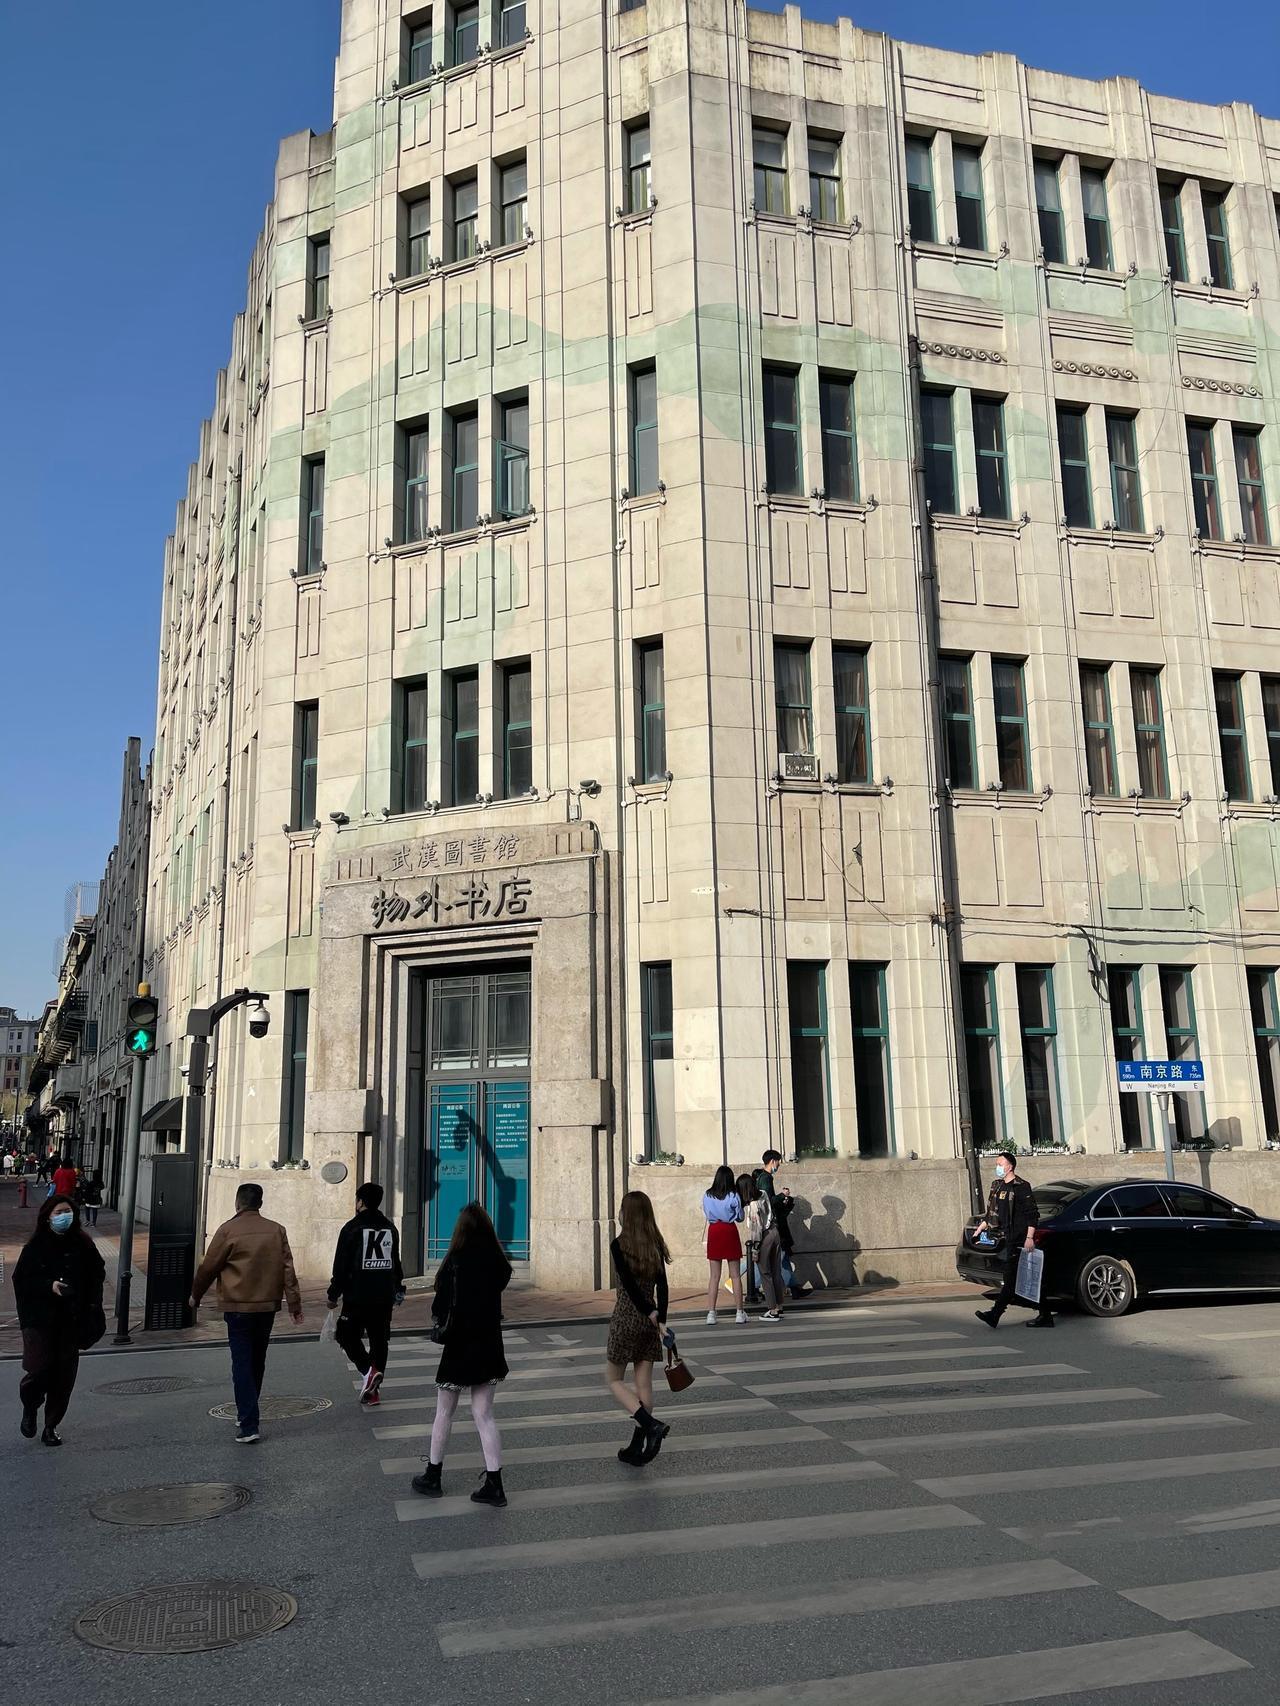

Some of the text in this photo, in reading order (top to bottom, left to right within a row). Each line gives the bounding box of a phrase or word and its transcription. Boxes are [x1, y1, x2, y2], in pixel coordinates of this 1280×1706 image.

[392, 834, 520, 872] 武漢圖書館
[1124, 1064, 1131, 1072] 西
[1140, 1064, 1182, 1078] 南京路
[1191, 1064, 1198, 1072] 东
[365, 1230, 387, 1259] K
